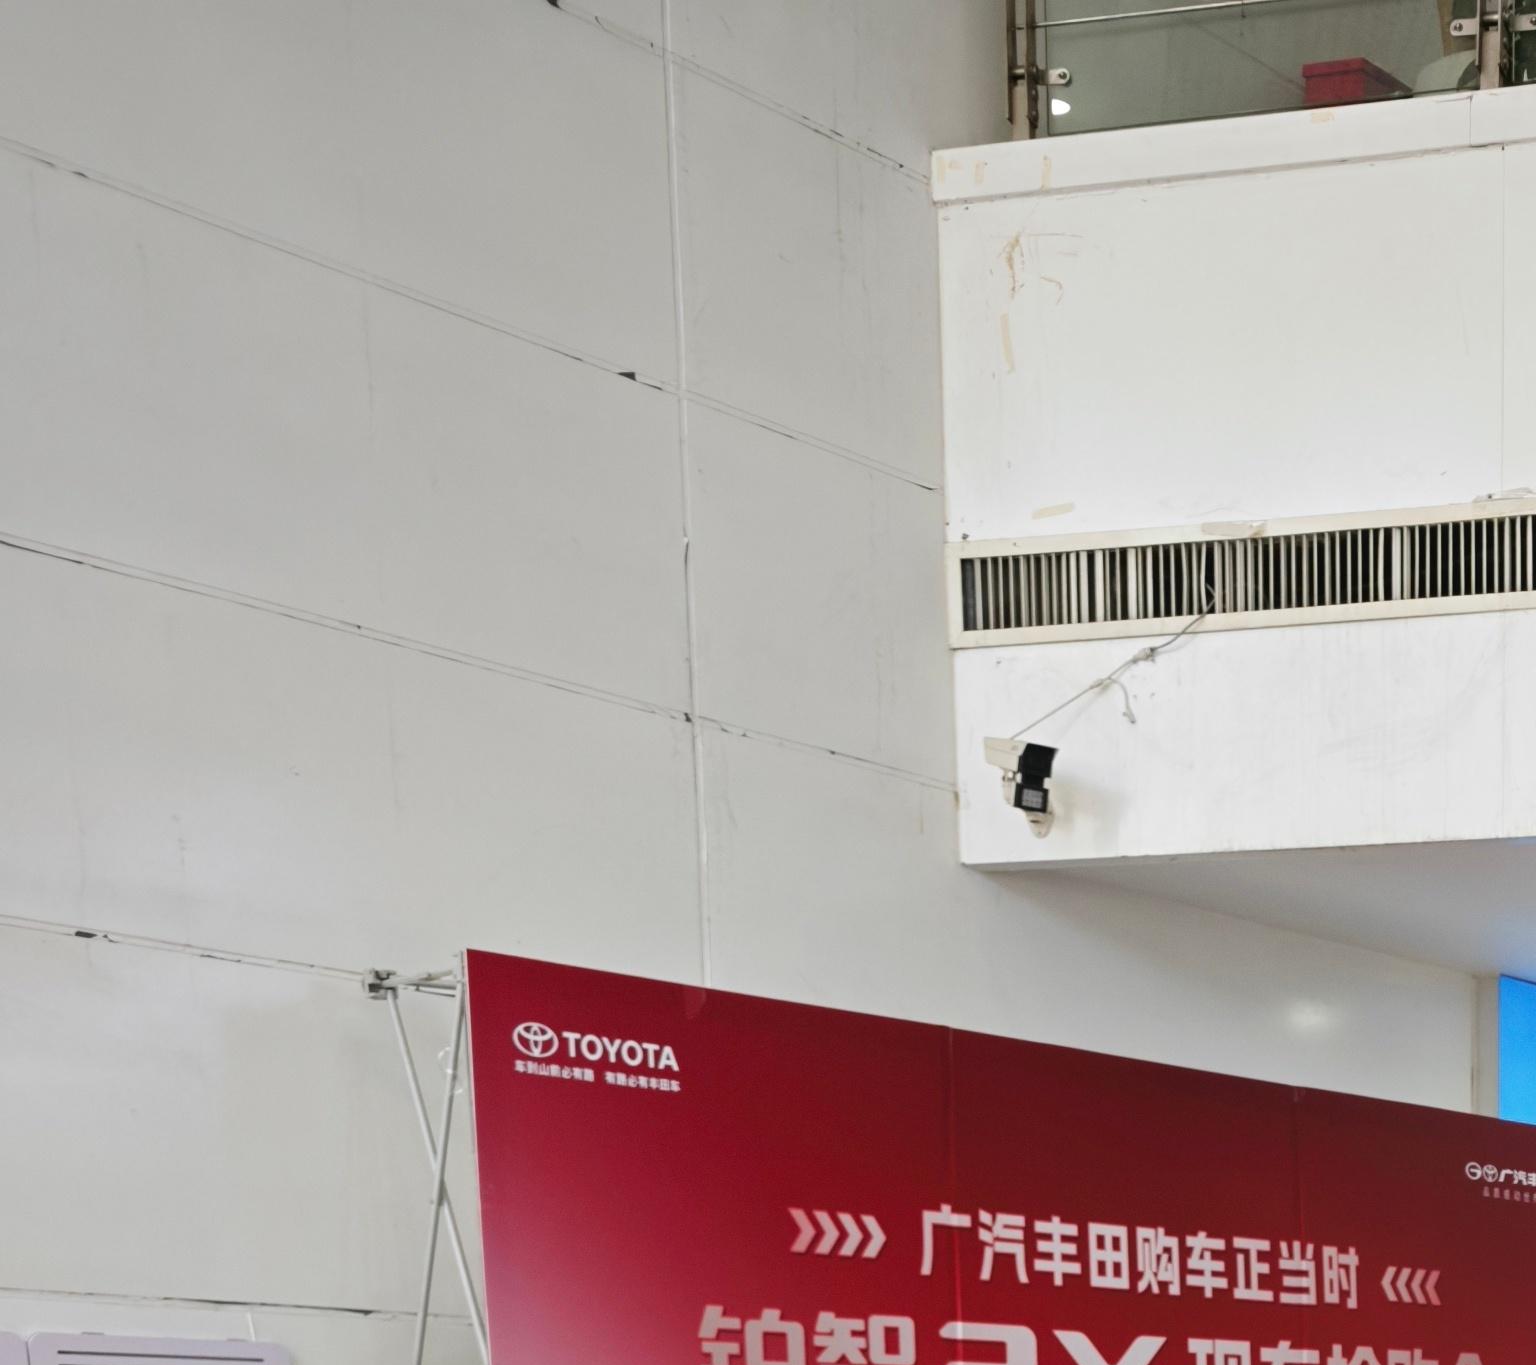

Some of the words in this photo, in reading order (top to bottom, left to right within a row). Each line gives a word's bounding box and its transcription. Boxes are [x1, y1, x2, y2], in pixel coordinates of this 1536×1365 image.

[562, 1031, 680, 1072] TOYOTA
[920, 1204, 1360, 1309] 广汽丰田购车正当时
